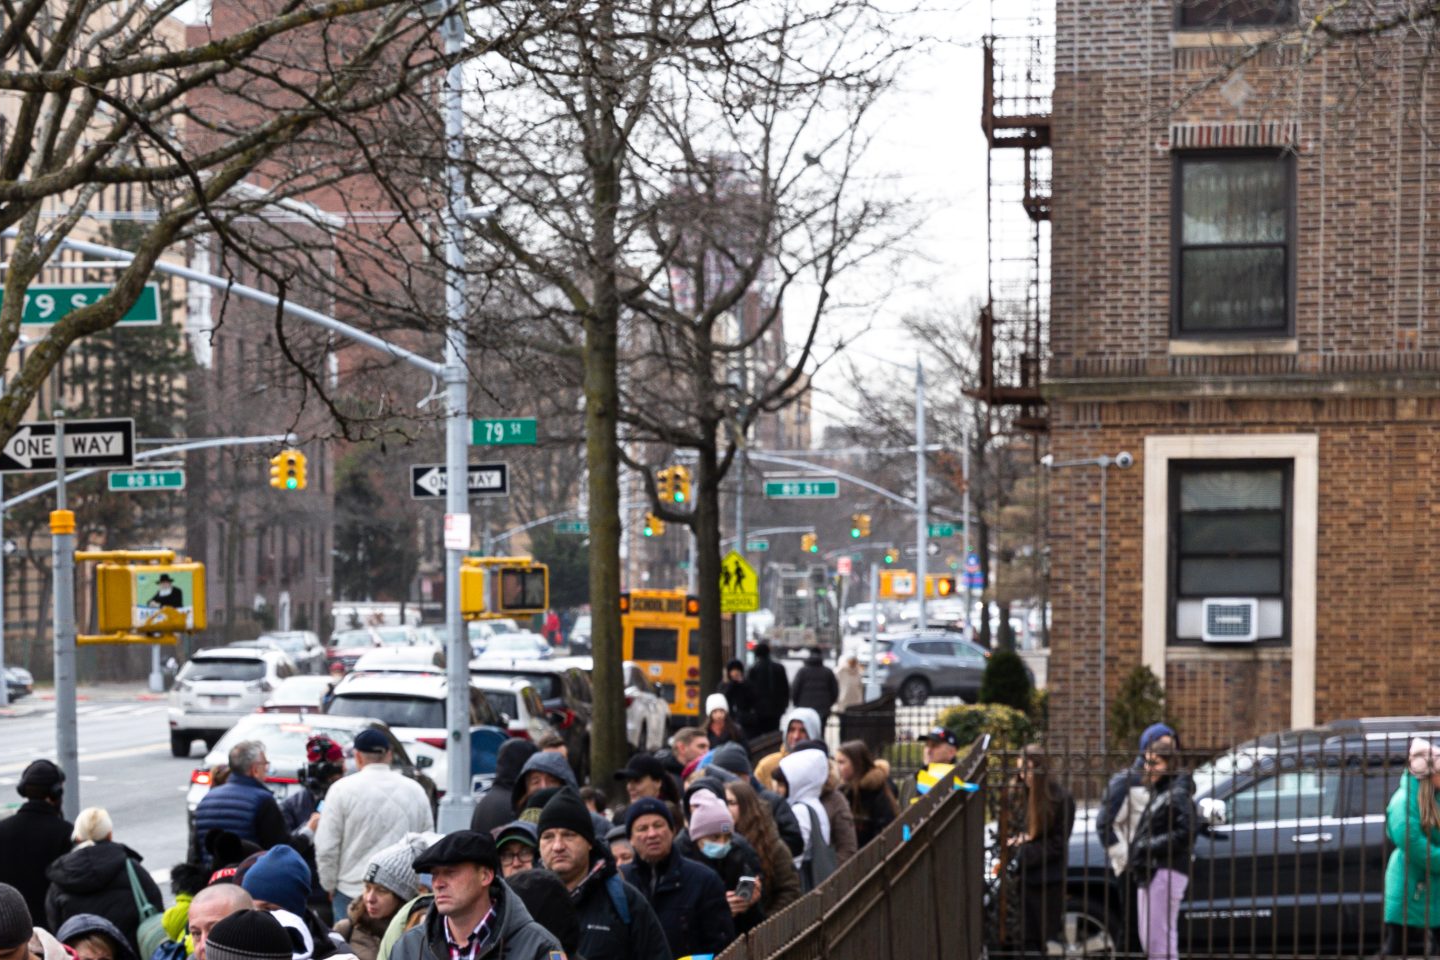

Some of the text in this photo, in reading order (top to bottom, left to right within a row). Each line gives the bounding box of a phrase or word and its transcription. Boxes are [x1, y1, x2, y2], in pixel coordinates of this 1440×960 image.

[485, 423, 504, 442] 79
[14, 436, 114, 457] ONE WAY
[127, 475, 145, 487] 80
[429, 473, 447, 488] ON
[633, 599, 663, 611] SCHOOL
